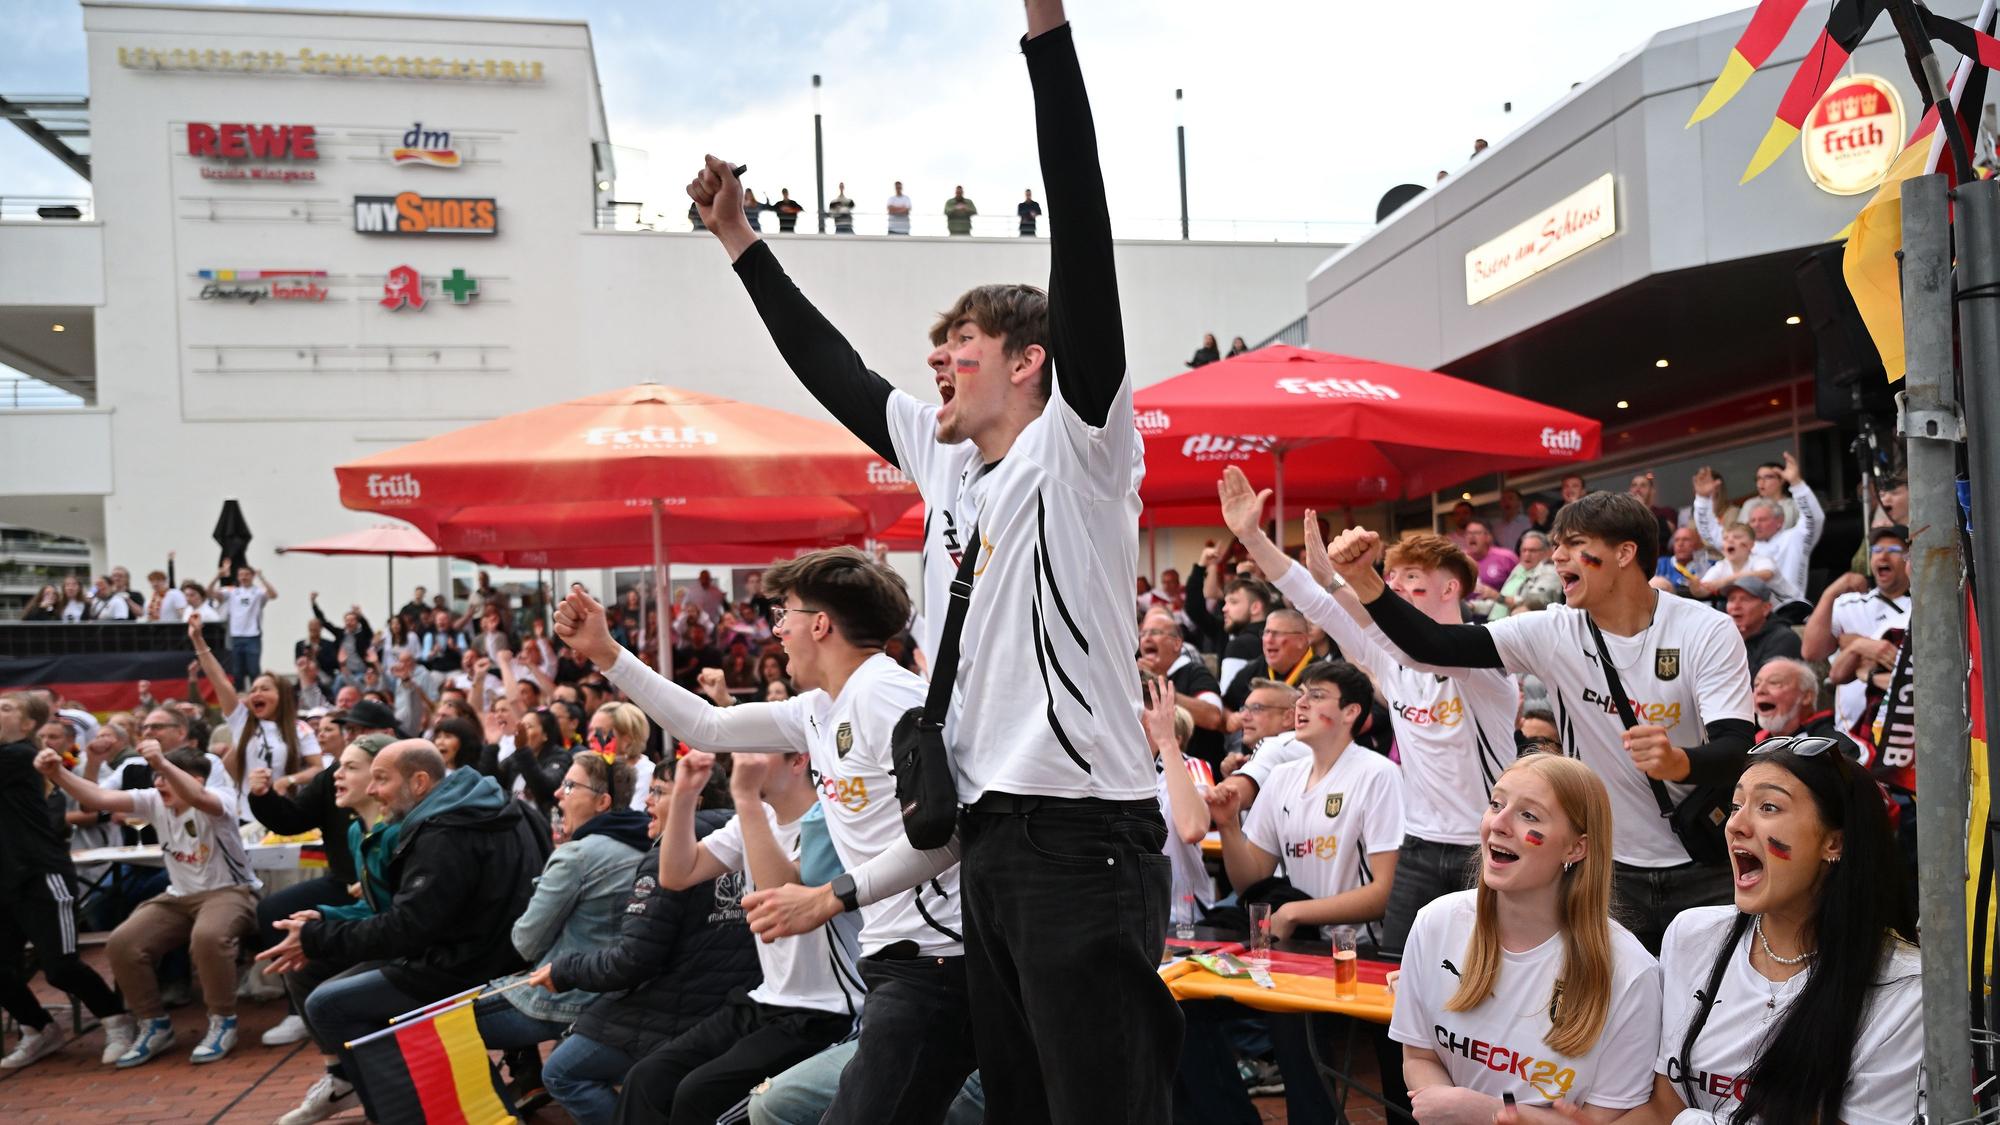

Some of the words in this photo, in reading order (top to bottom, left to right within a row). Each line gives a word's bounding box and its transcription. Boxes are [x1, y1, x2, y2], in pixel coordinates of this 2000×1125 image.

[187, 122, 318, 161] REWE
[403, 123, 449, 150] dm
[1823, 122, 1883, 154] früh
[1515, 242, 1536, 261] am
[1537, 206, 1601, 255] Schloss
[1275, 378, 1400, 399] früh
[1540, 426, 1582, 452] früh
[366, 473, 421, 499] früh
[1434, 1025, 1576, 1094] CHECK24
